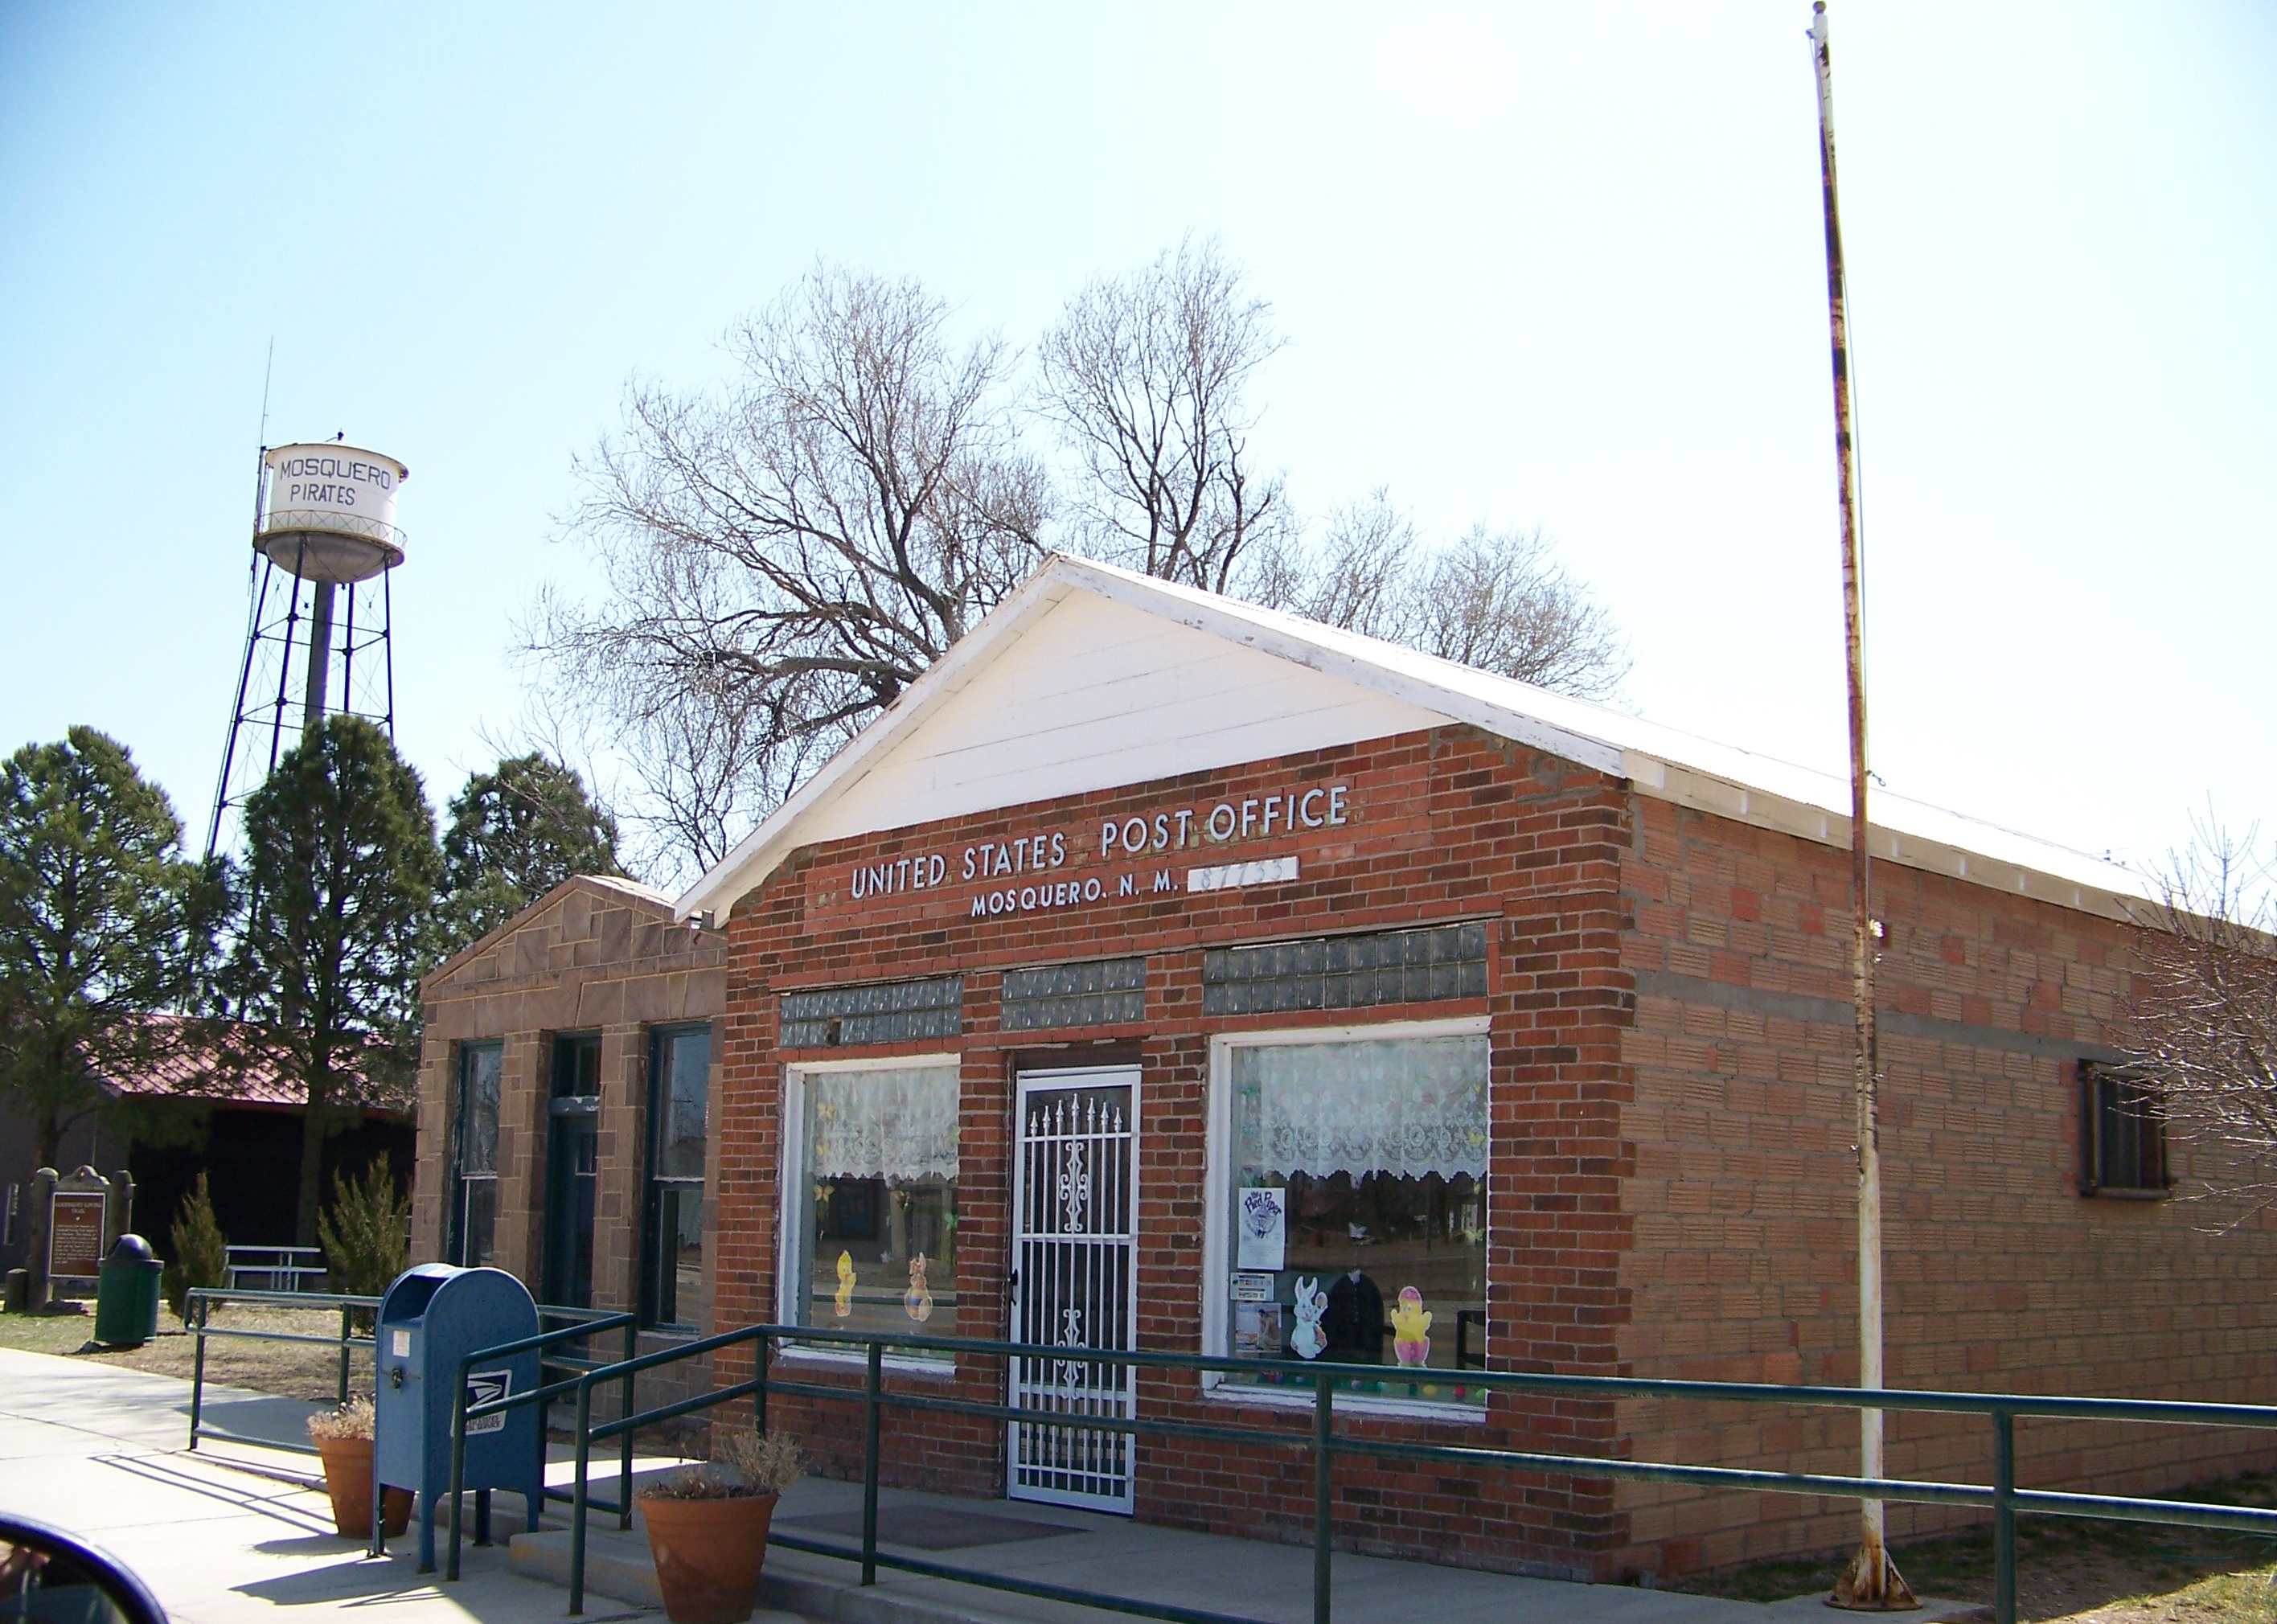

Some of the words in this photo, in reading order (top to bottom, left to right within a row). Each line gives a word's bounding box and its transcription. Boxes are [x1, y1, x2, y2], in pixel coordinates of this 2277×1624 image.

[281, 458, 392, 490] MOSQUERO
[290, 484, 355, 506] PIRATES
[851, 854, 946, 900] UNITED
[962, 832, 1066, 880] STATES
[1102, 809, 1193, 858] POST
[1209, 785, 1348, 841] OFFICE
[1119, 873, 1140, 898] N.
[1153, 867, 1180, 894] M.
[1244, 1192, 1262, 1215] Pied
[1264, 1191, 1282, 1216] Piper
